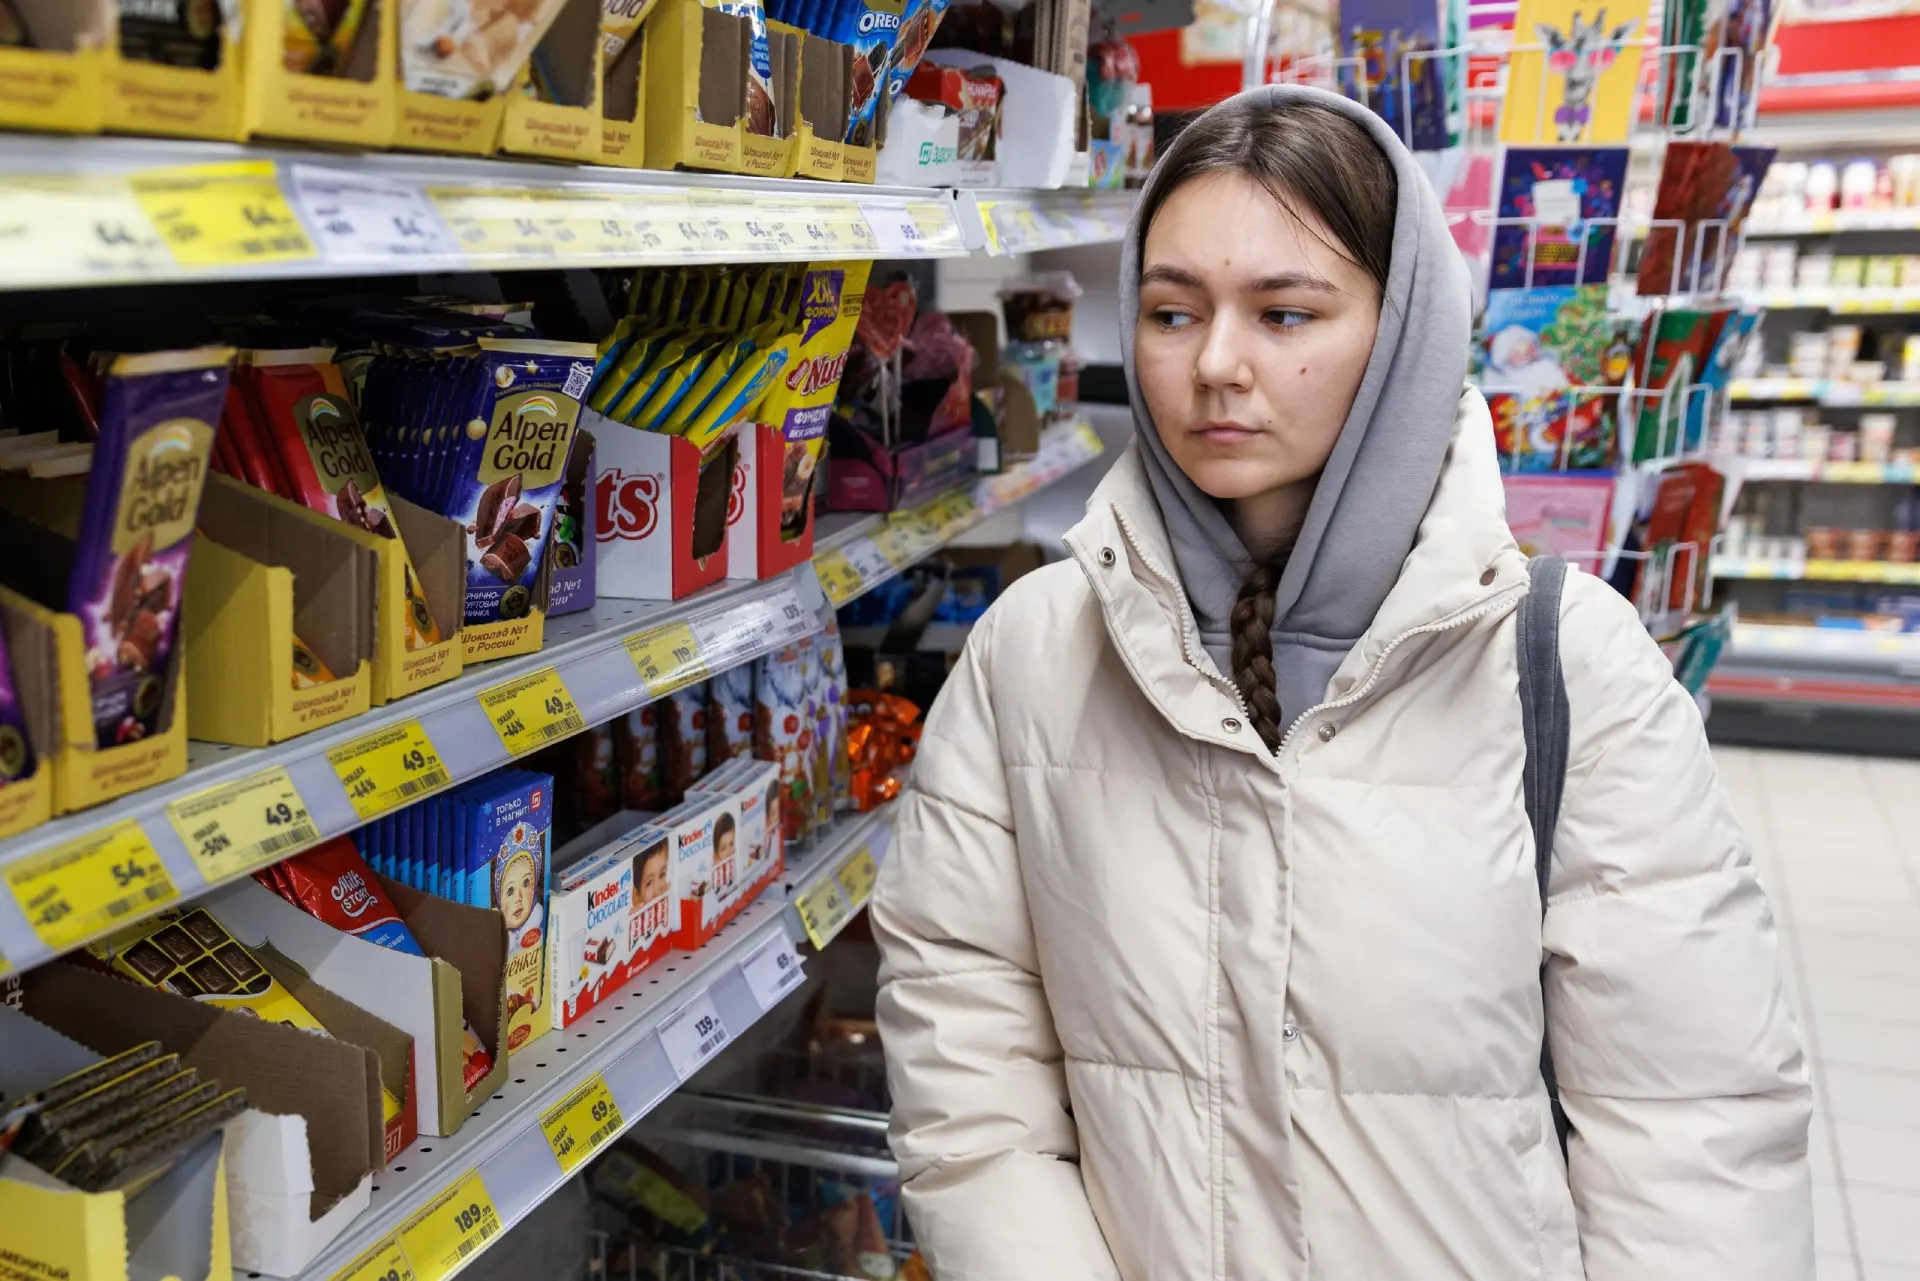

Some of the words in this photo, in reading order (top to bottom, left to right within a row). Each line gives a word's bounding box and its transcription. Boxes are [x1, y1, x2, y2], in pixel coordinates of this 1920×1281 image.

[858, 11, 900, 33] OREO
[794, 407, 829, 425] ФУНДУК
[306, 418, 364, 450] Alpen
[493, 411, 569, 450] Alpen
[319, 449, 368, 478] Gold
[493, 442, 557, 471] Gold
[134, 455, 200, 492] Alpen
[126, 486, 189, 533] Gold
[562, 578, 582, 593] №1
[460, 626, 509, 644] Шоколад
[510, 624, 529, 636] №1
[402, 652, 436, 672] Шоколад
[437, 648, 450, 660] №1
[672, 646, 692, 665] 119
[496, 708, 517, 726] СКИДКА
[545, 695, 565, 716] 49
[403, 749, 426, 772] 49
[266, 803, 293, 826] 49
[496, 798, 523, 815] ТОЛЬКО
[496, 818, 501, 827] В
[502, 805, 530, 824] МАГНИТ!
[678, 827, 704, 850] Kinder
[110, 858, 147, 887] 54
[330, 869, 366, 901] Milk
[587, 879, 621, 912] Kinder
[343, 888, 371, 910] STORY
[587, 890, 630, 930] CHOCOLATE
[694, 1015, 714, 1038] 139
[592, 1100, 608, 1122] 69
[552, 1124, 569, 1147] СКИДКА
[455, 1203, 482, 1235] 189
[482, 1205, 492, 1218] .99
